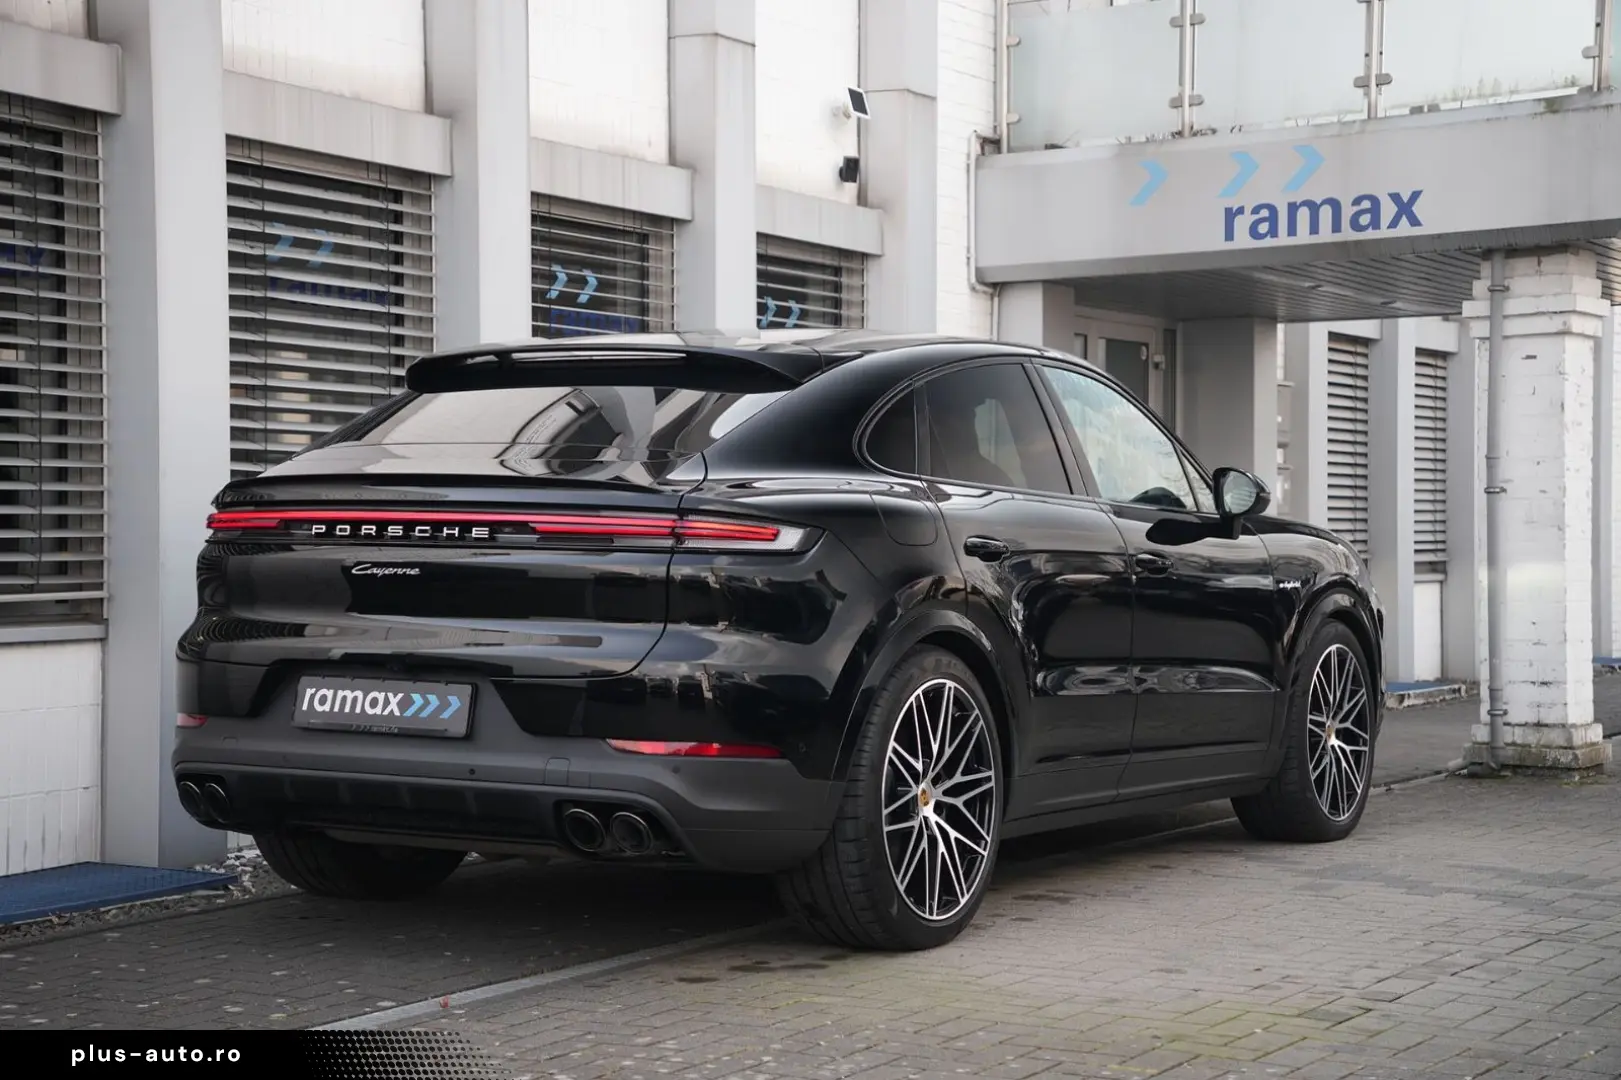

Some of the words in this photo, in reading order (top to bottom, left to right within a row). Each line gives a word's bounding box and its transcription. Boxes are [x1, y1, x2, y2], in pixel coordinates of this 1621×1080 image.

[1224, 189, 1424, 242] ramax
[311, 524, 490, 538] PORSCHE
[351, 563, 421, 578] Cayenne
[301, 687, 404, 717] ramax
